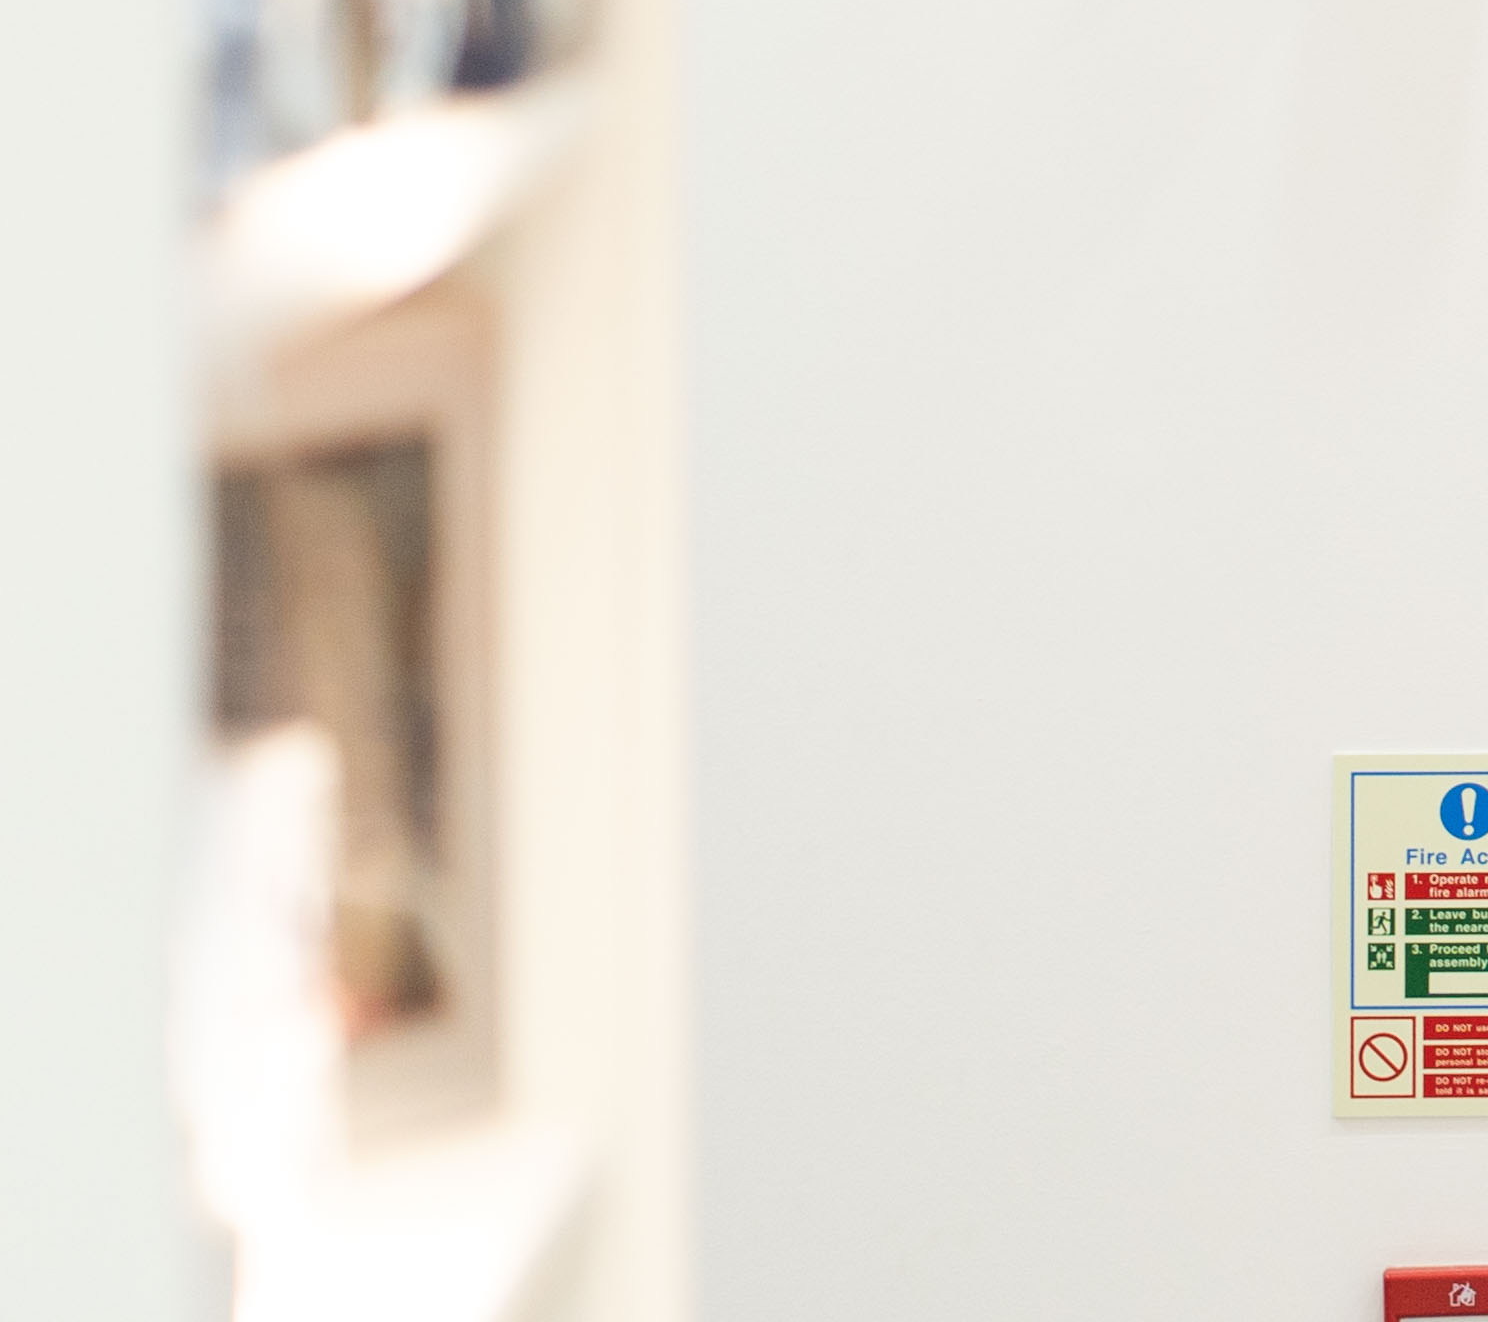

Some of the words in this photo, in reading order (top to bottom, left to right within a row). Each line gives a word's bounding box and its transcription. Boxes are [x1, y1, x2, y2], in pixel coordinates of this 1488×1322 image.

[1405, 848, 1448, 866] Fire
[1411, 874, 1423, 885] 1.
[1429, 874, 1479, 887] Operate
[1429, 887, 1451, 898] fire
[1411, 909, 1423, 920] 2.
[1429, 909, 1467, 920] Leave
[1429, 922, 1449, 933] the
[1411, 944, 1423, 955] 3.
[1429, 944, 1481, 955] Proceed
[1429, 957, 1488, 969] assembly
[1435, 1024, 1450, 1033] DO
[1453, 1024, 1472, 1033] NOT
[1435, 1048, 1450, 1056] DO
[1453, 1048, 1472, 1056] NOT
[1435, 1058, 1474, 1067] personal
[1435, 1077, 1450, 1085] DO
[1453, 1077, 1472, 1085] NOT
